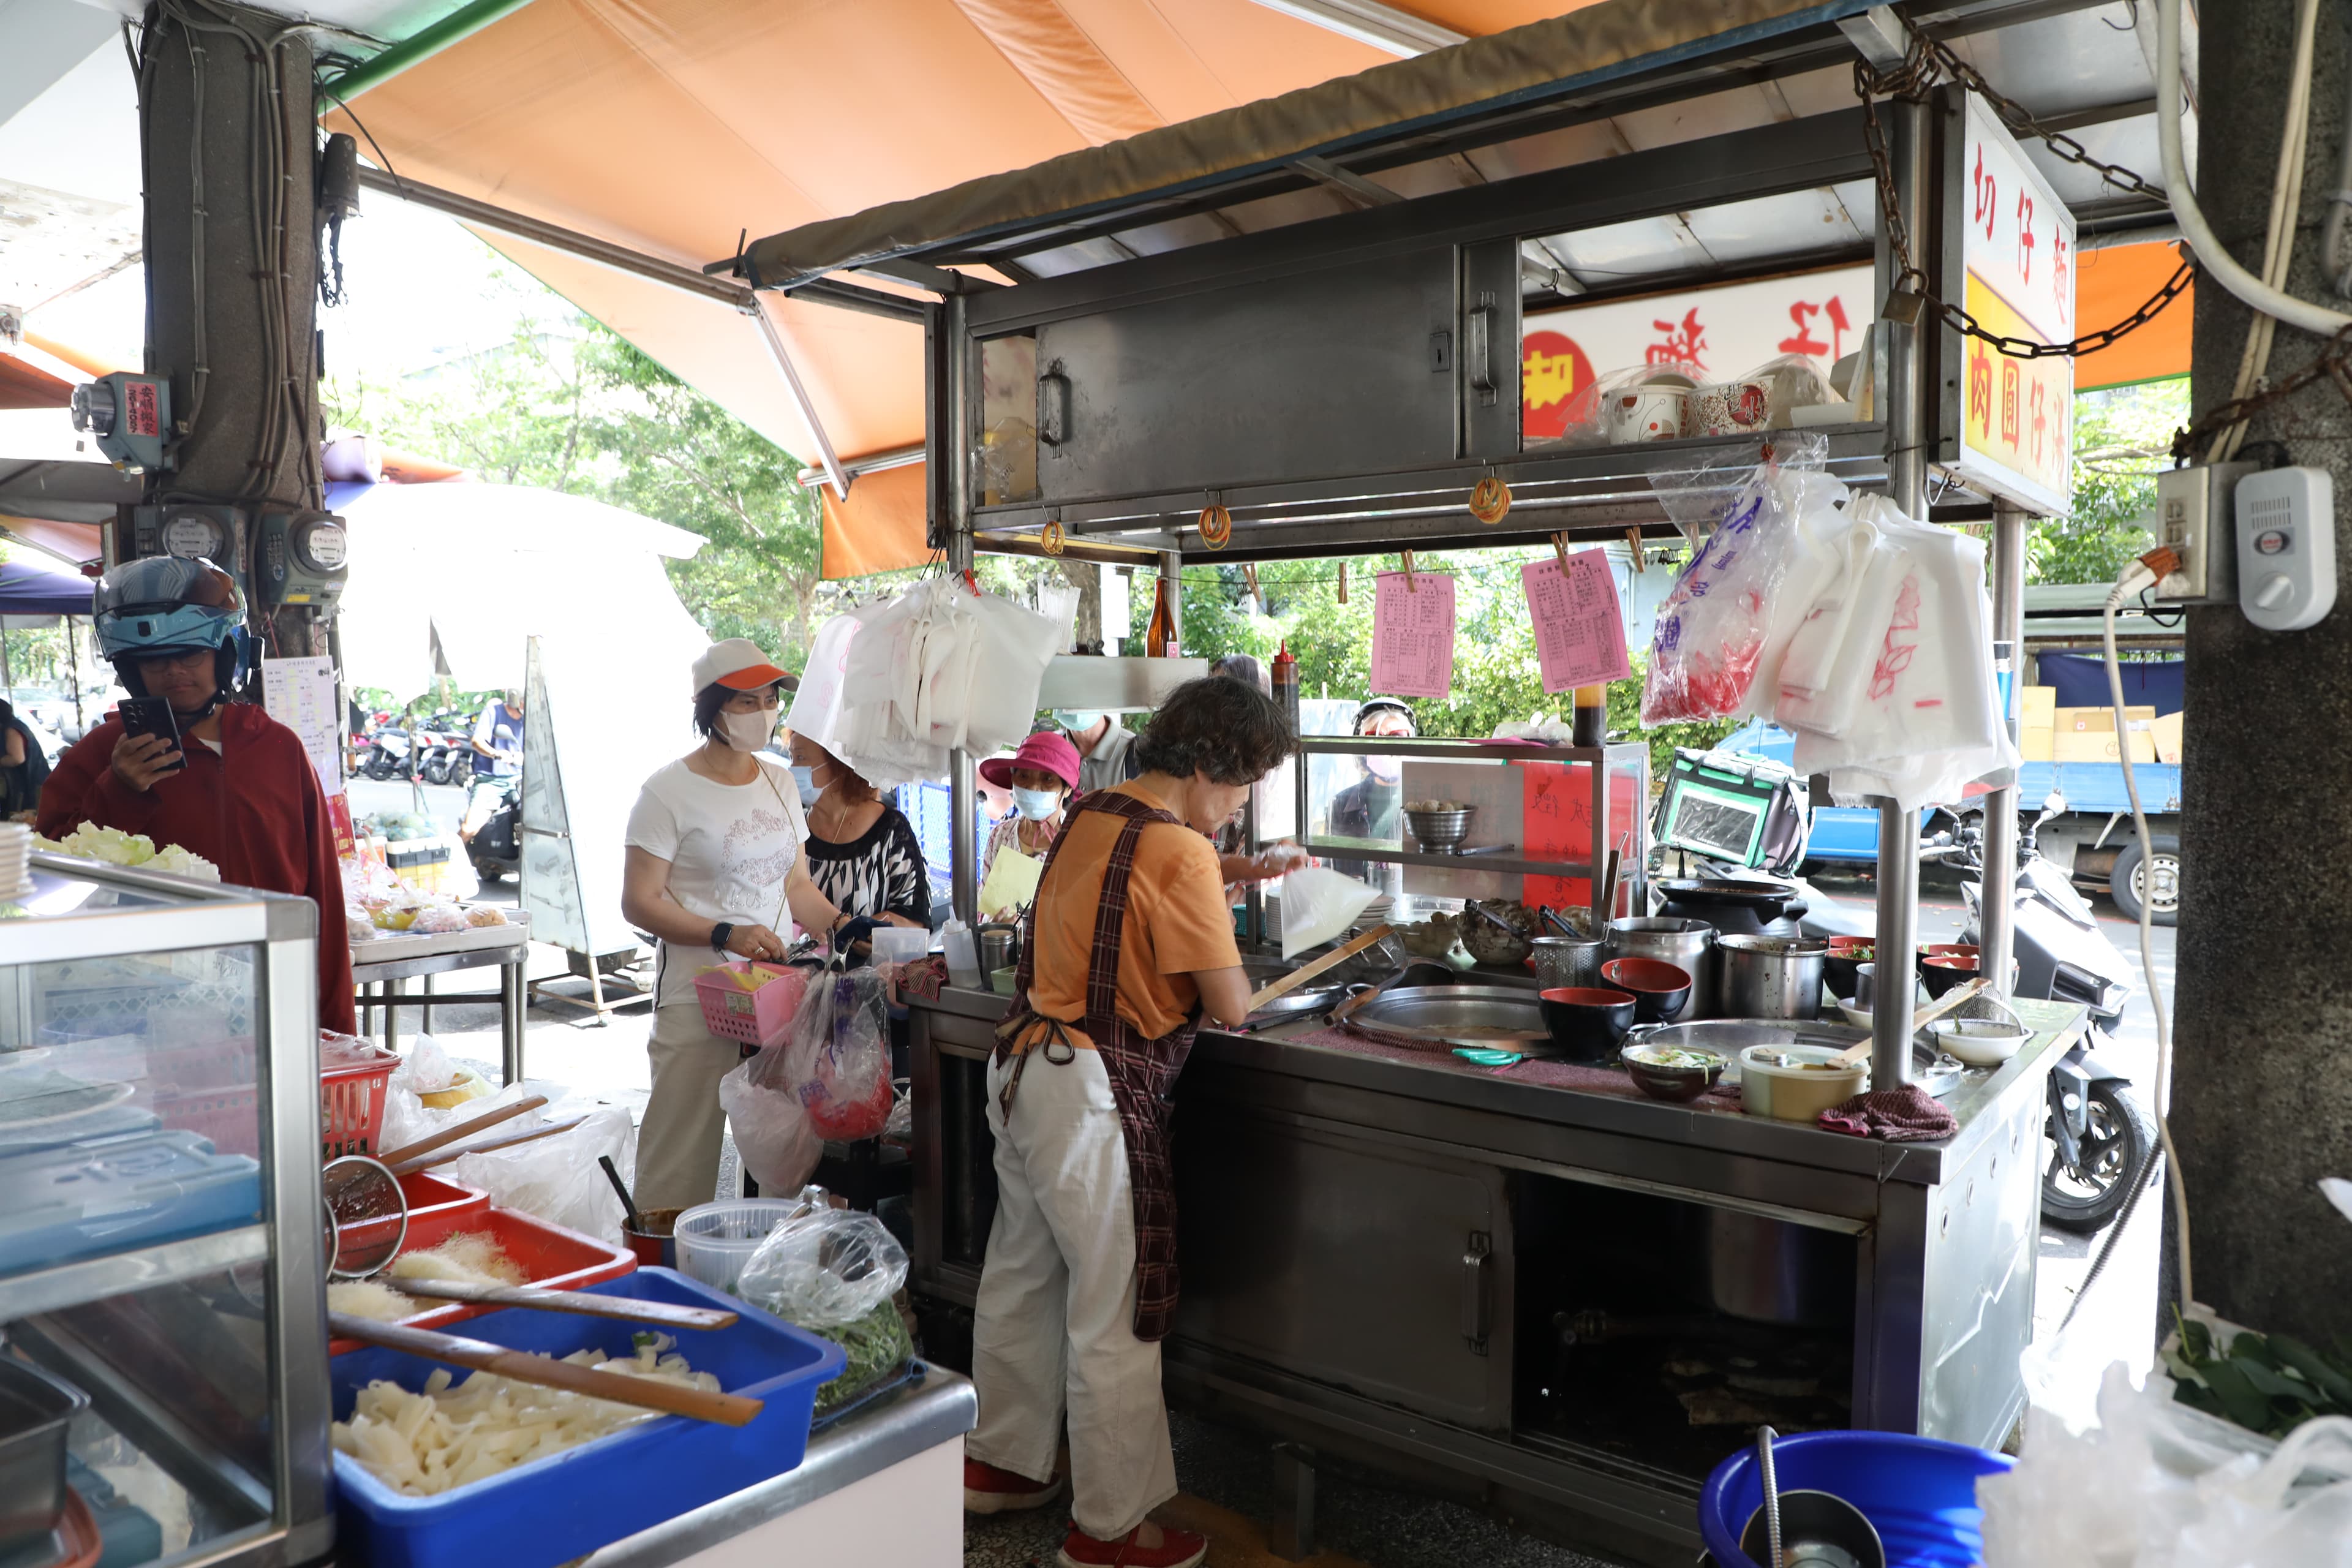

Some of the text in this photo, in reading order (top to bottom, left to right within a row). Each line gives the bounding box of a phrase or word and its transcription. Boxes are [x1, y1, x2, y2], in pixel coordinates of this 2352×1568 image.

[1973, 141, 2068, 325] 切仔麵
[1970, 340, 2067, 484] 肉圓仔湯
